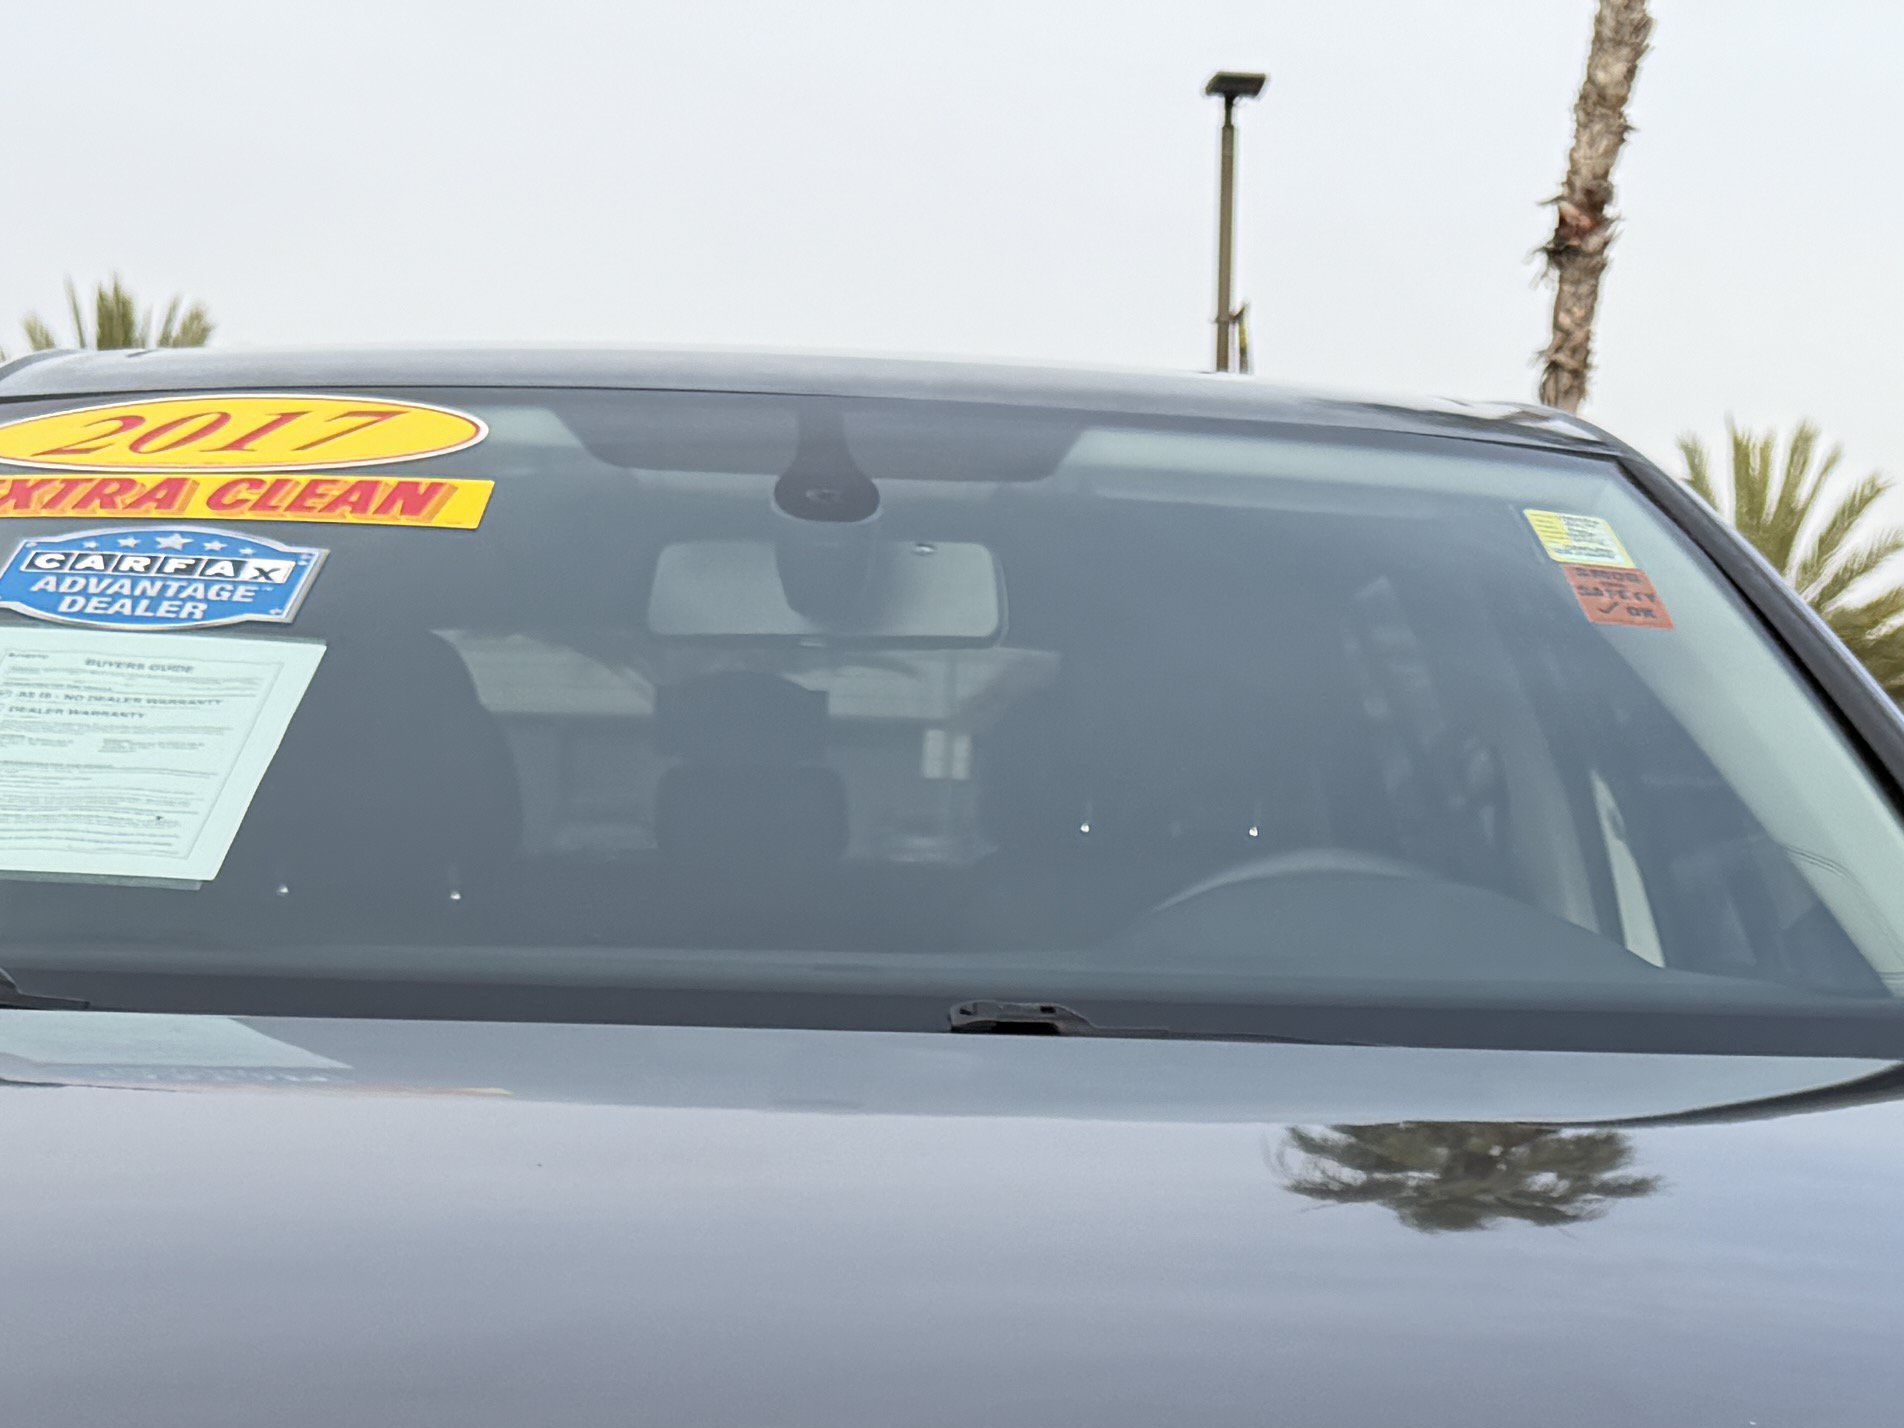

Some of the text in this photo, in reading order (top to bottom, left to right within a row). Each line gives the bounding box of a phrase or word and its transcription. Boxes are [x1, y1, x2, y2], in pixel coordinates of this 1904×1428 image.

[30, 410, 411, 457] 2017
[205, 477, 458, 523] CLEAN
[26, 552, 288, 583] CARFAX
[56, 595, 209, 619] DEALER
